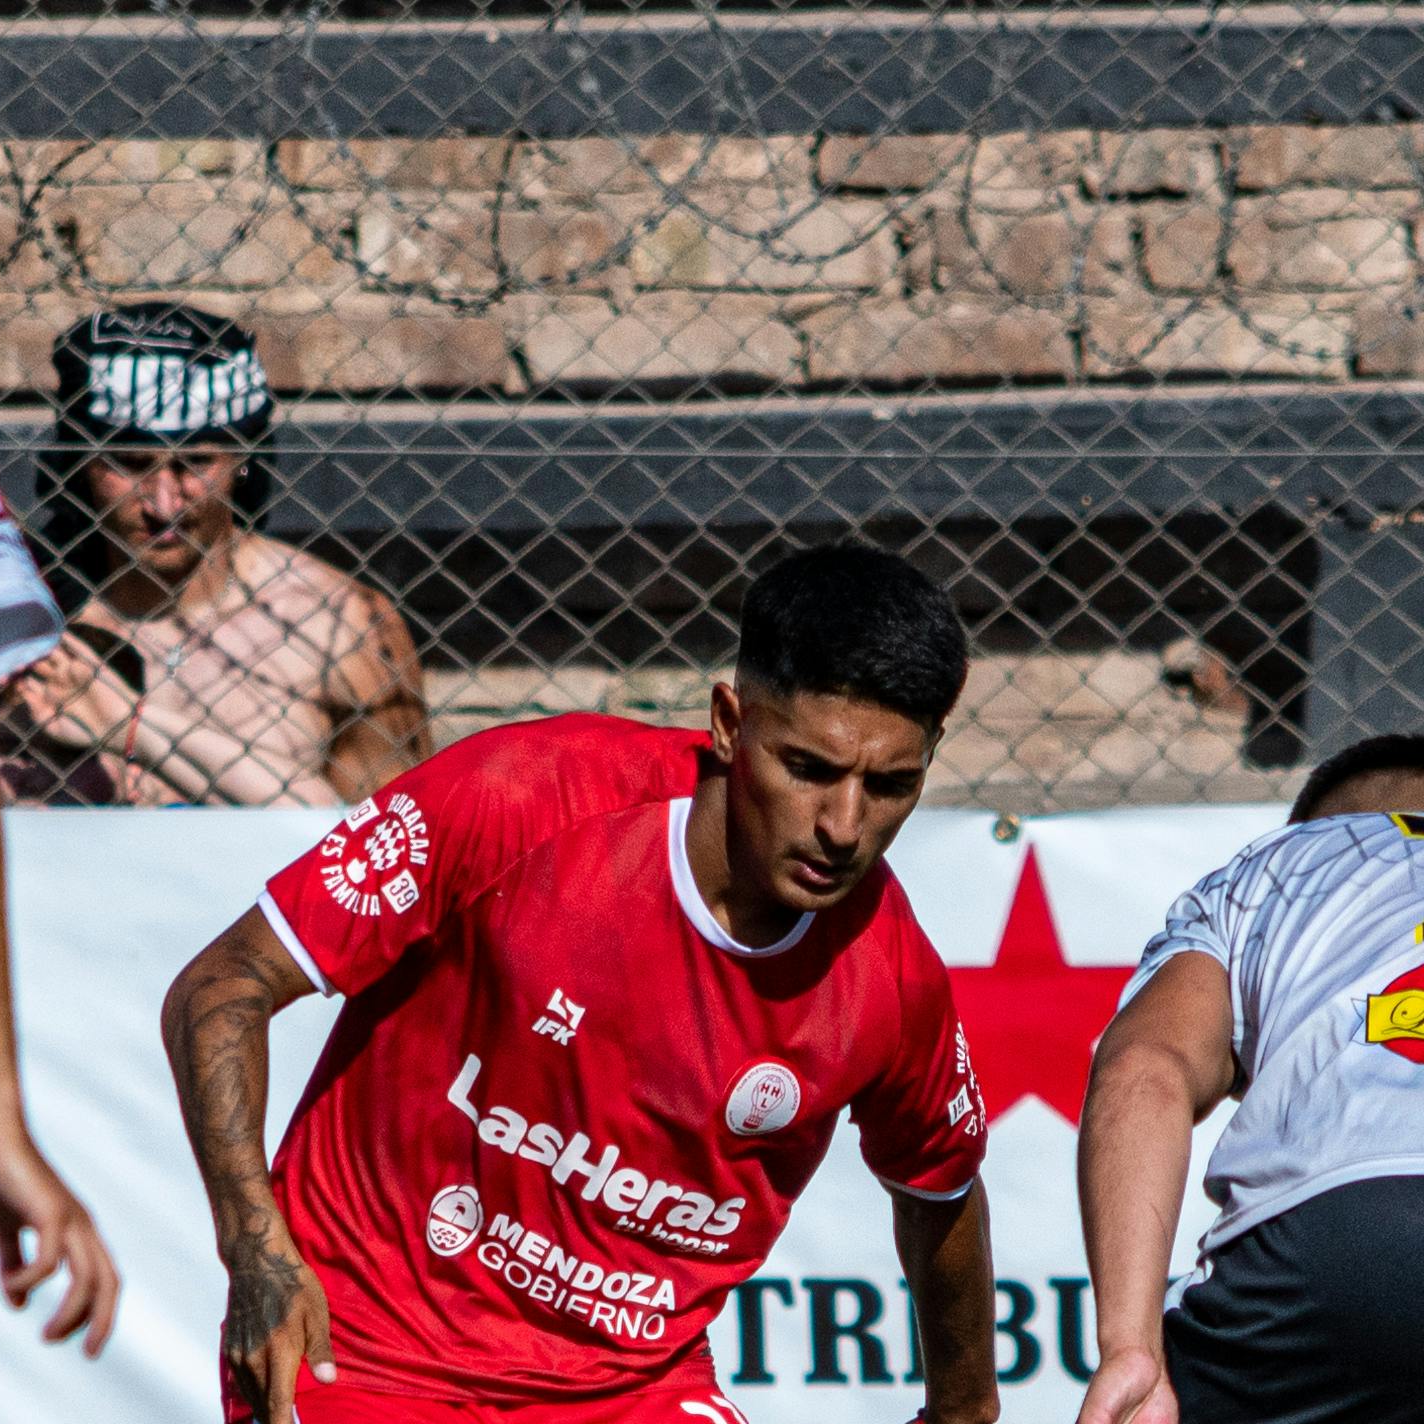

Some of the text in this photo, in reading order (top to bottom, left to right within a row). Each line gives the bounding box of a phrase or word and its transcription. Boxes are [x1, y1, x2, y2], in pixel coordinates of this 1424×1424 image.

[320, 864, 381, 916] FAMILIA
[389, 878, 416, 907] 39
[531, 1015, 577, 1046] IFK
[486, 1213, 676, 1311] MENDOZA
[477, 1241, 666, 1340] GOBIERNO
